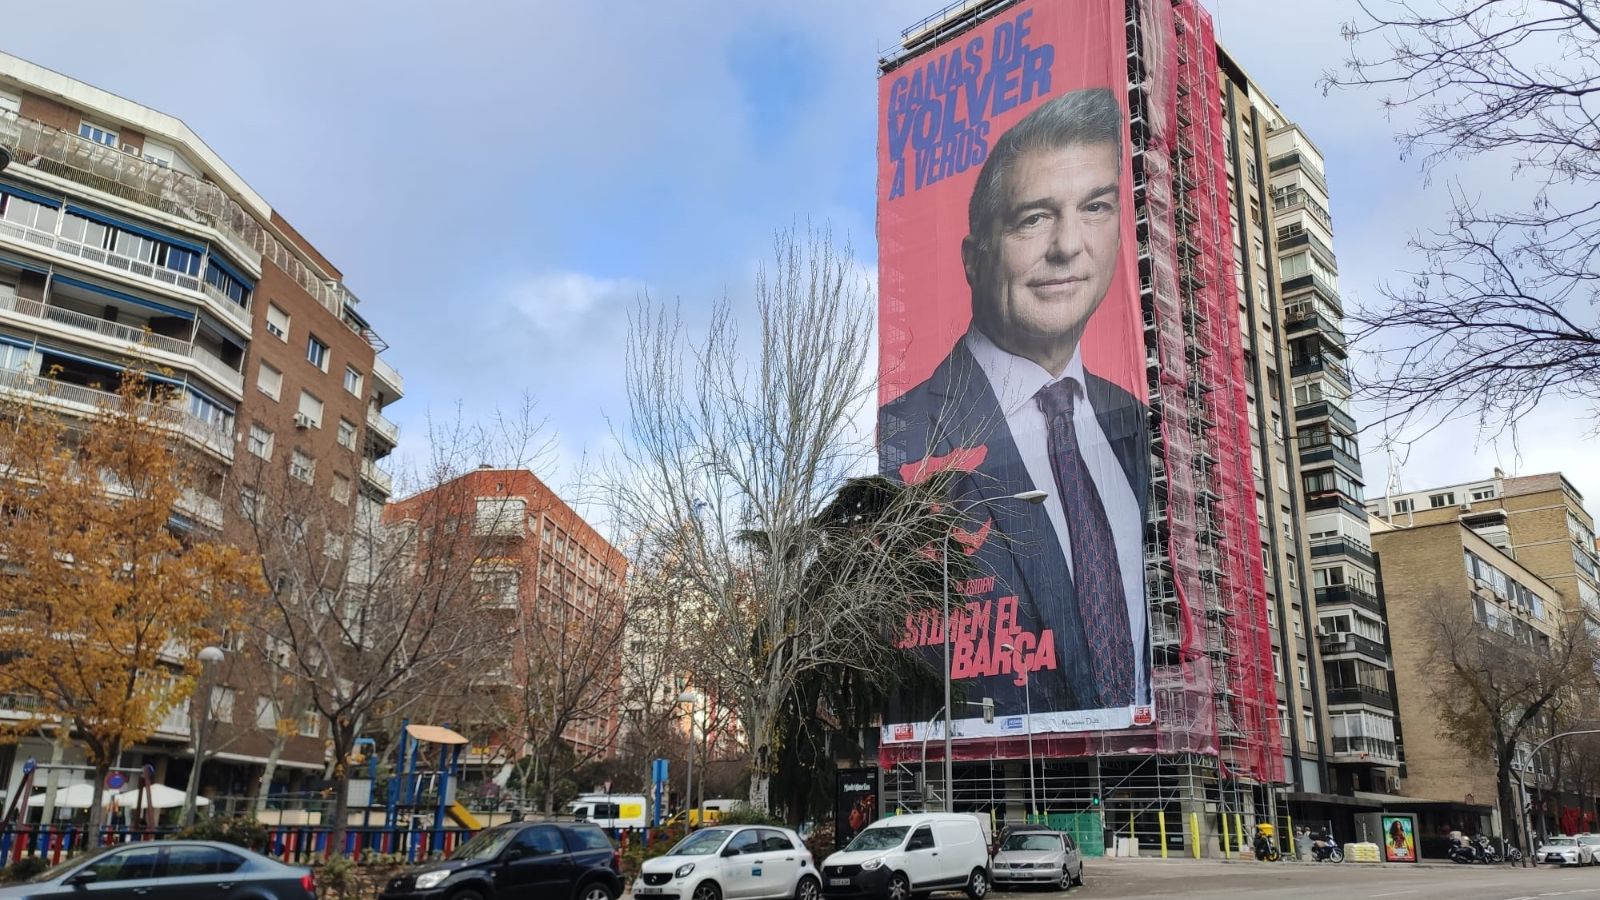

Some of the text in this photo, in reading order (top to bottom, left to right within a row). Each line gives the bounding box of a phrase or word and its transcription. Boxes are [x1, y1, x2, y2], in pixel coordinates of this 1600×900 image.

[890, 9, 1034, 112] GANAS DE
[888, 43, 1056, 162] VOLVER
[889, 121, 990, 201] A VEROS
[997, 595, 1022, 635] EL
[951, 629, 1057, 687] BARÇA
